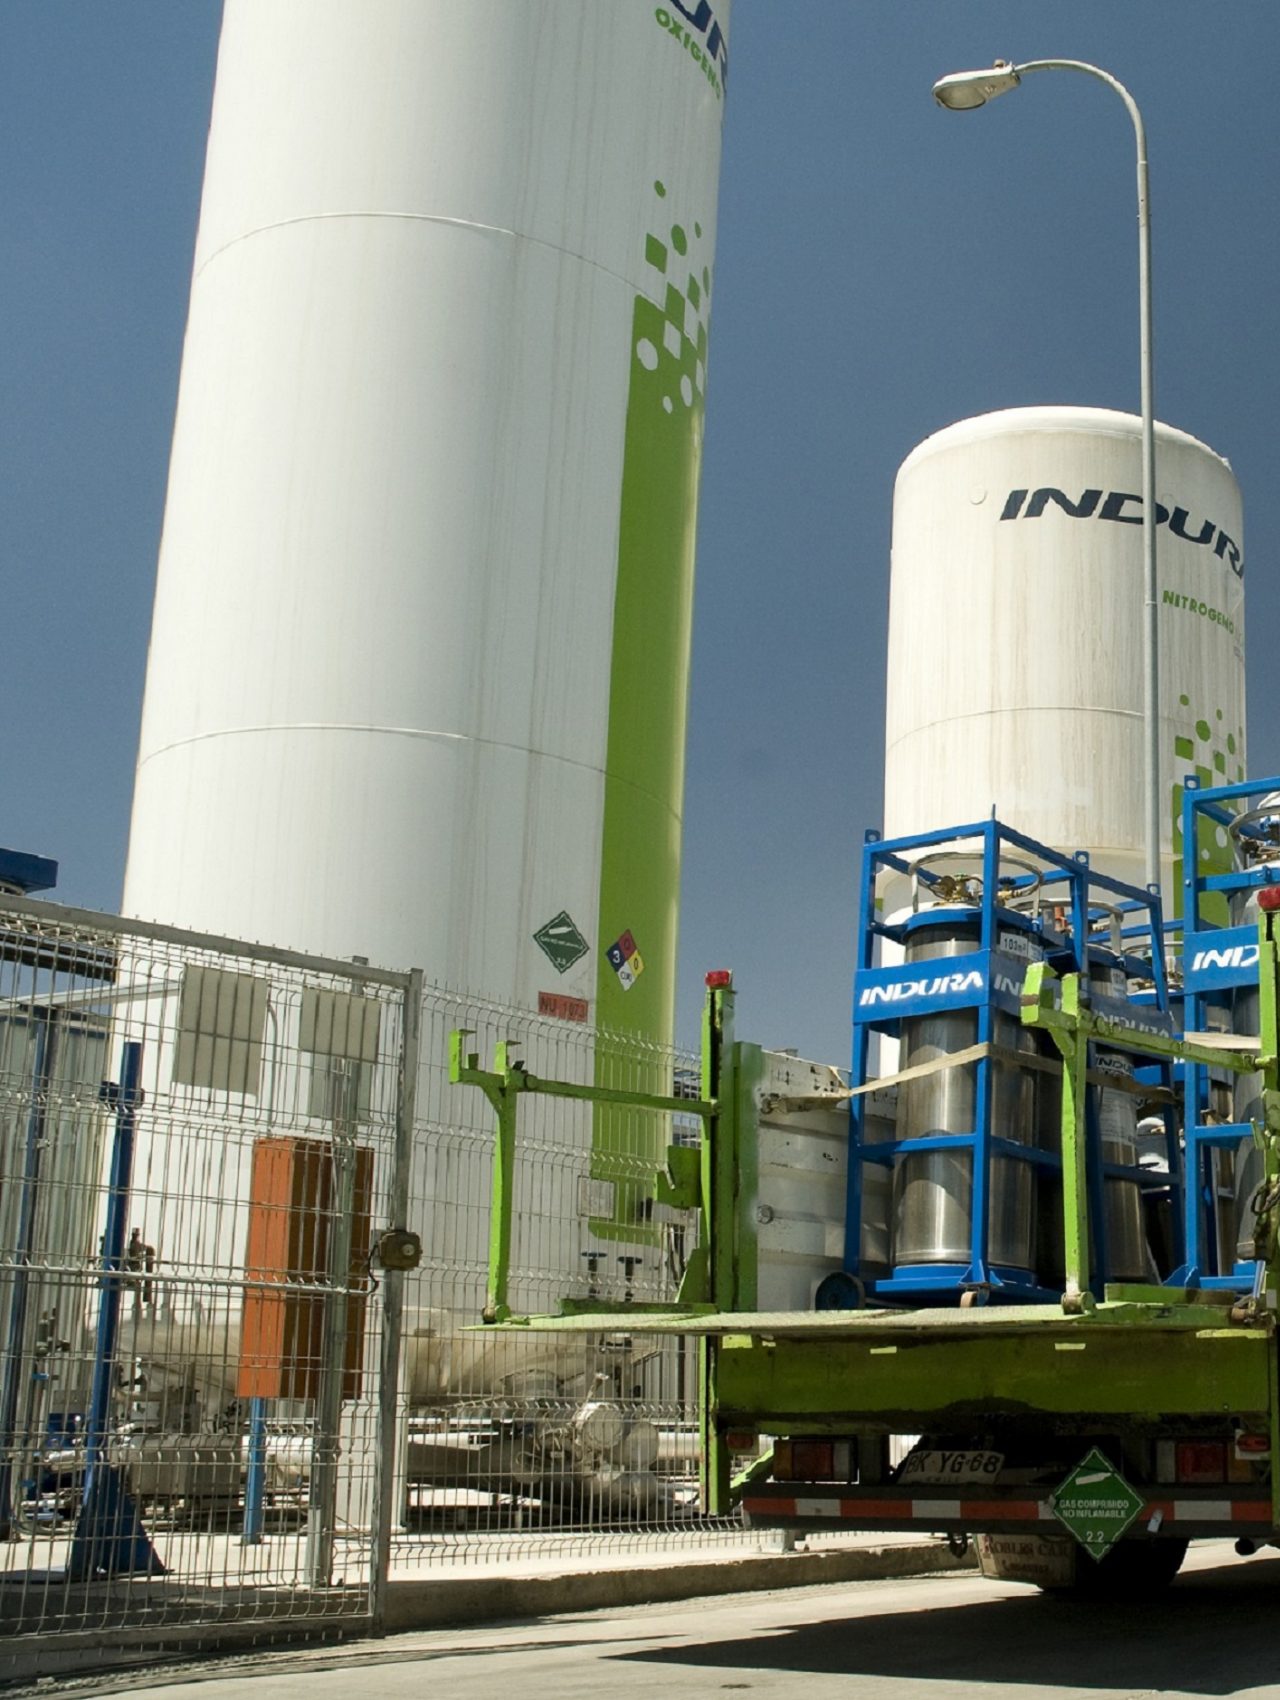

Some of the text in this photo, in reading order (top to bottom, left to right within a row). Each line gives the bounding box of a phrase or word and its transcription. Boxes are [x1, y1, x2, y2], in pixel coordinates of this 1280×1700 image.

[1000, 487, 1244, 580] INDUR
[1162, 590, 1234, 634] NITROGENO
[612, 950, 621, 964] 3
[860, 971, 984, 1006] INDURA
[1060, 1500, 1129, 1509] GAS COMPRIMIDO
[1062, 1510, 1127, 1518] NO INFLAMABLE
